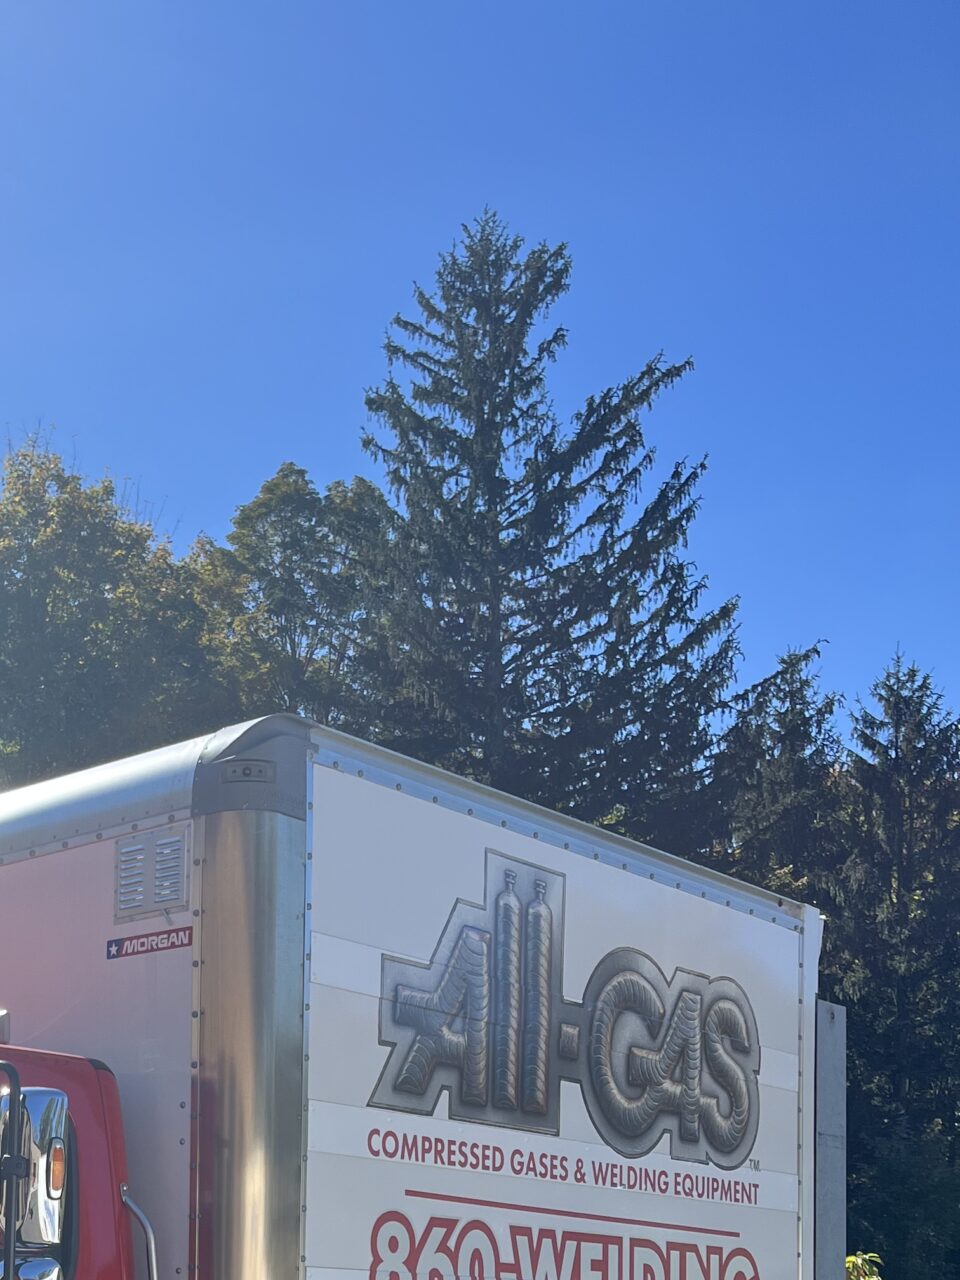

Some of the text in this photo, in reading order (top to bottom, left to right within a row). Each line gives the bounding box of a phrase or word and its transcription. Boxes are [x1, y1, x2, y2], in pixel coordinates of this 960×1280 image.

[122, 930, 190, 955] MORGAN
[367, 1128, 760, 1205] COMPRESSED GASES & WELDING EQUIPMENT
